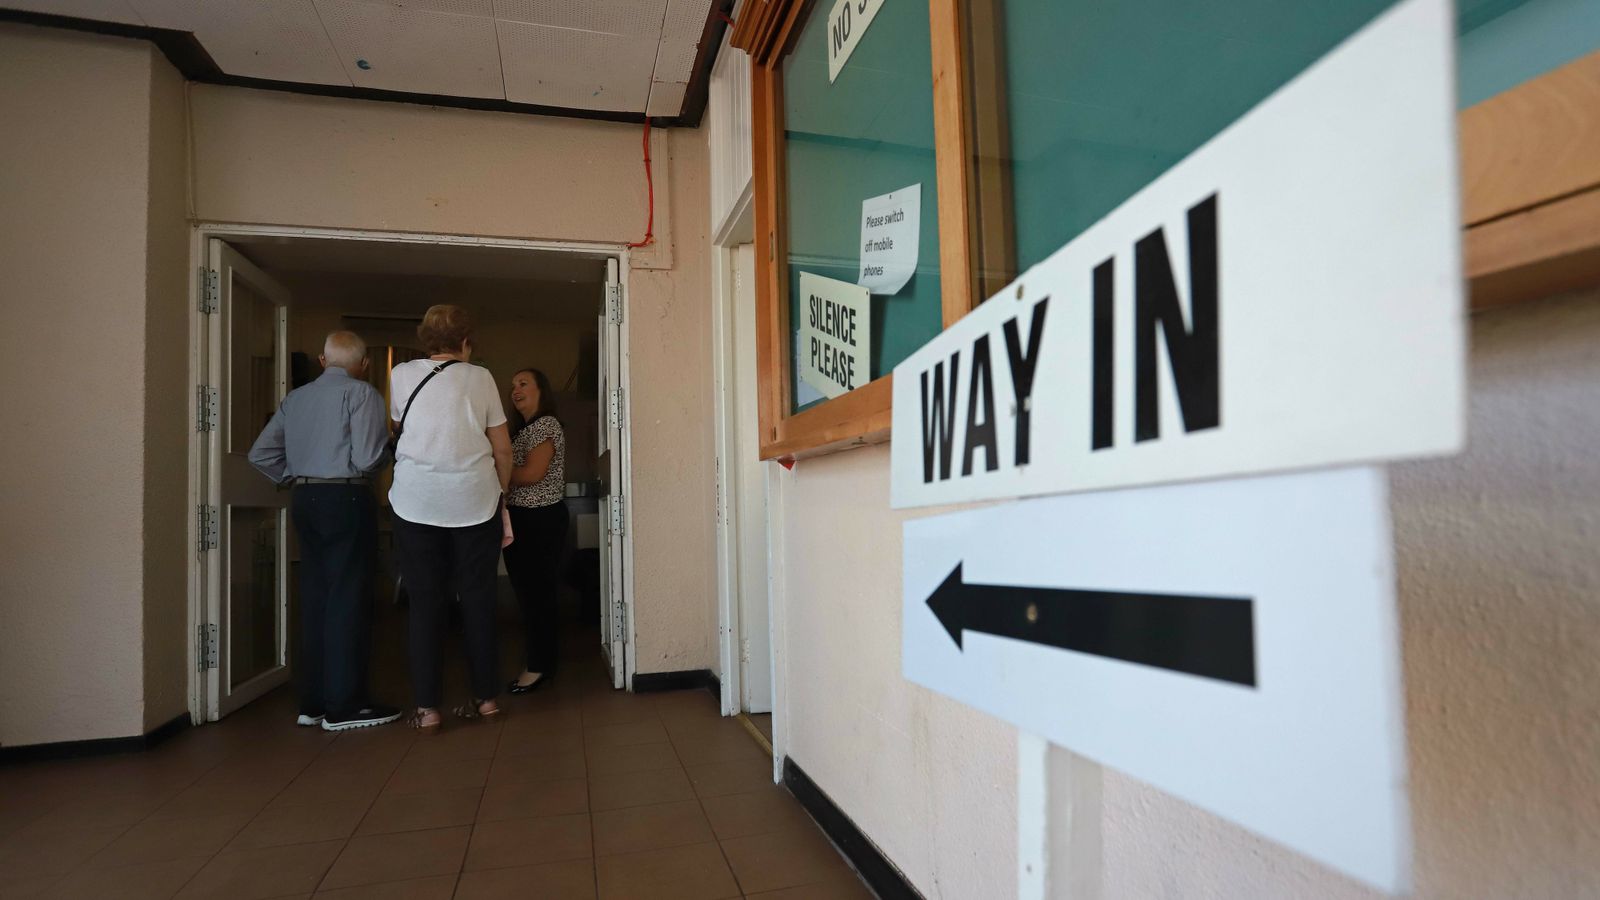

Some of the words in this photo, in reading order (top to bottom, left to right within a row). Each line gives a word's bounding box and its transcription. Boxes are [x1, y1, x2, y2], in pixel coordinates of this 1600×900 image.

[833, 1, 851, 59] NO
[865, 239, 873, 253] off
[874, 236, 893, 251] mobile
[866, 215, 884, 229] Please
[885, 207, 904, 225] switch
[864, 264, 884, 279] phones
[809, 294, 857, 347] SILENCE
[920, 295, 1050, 484] WAY
[1091, 190, 1221, 452] IN
[811, 336, 855, 391] PLEASE
